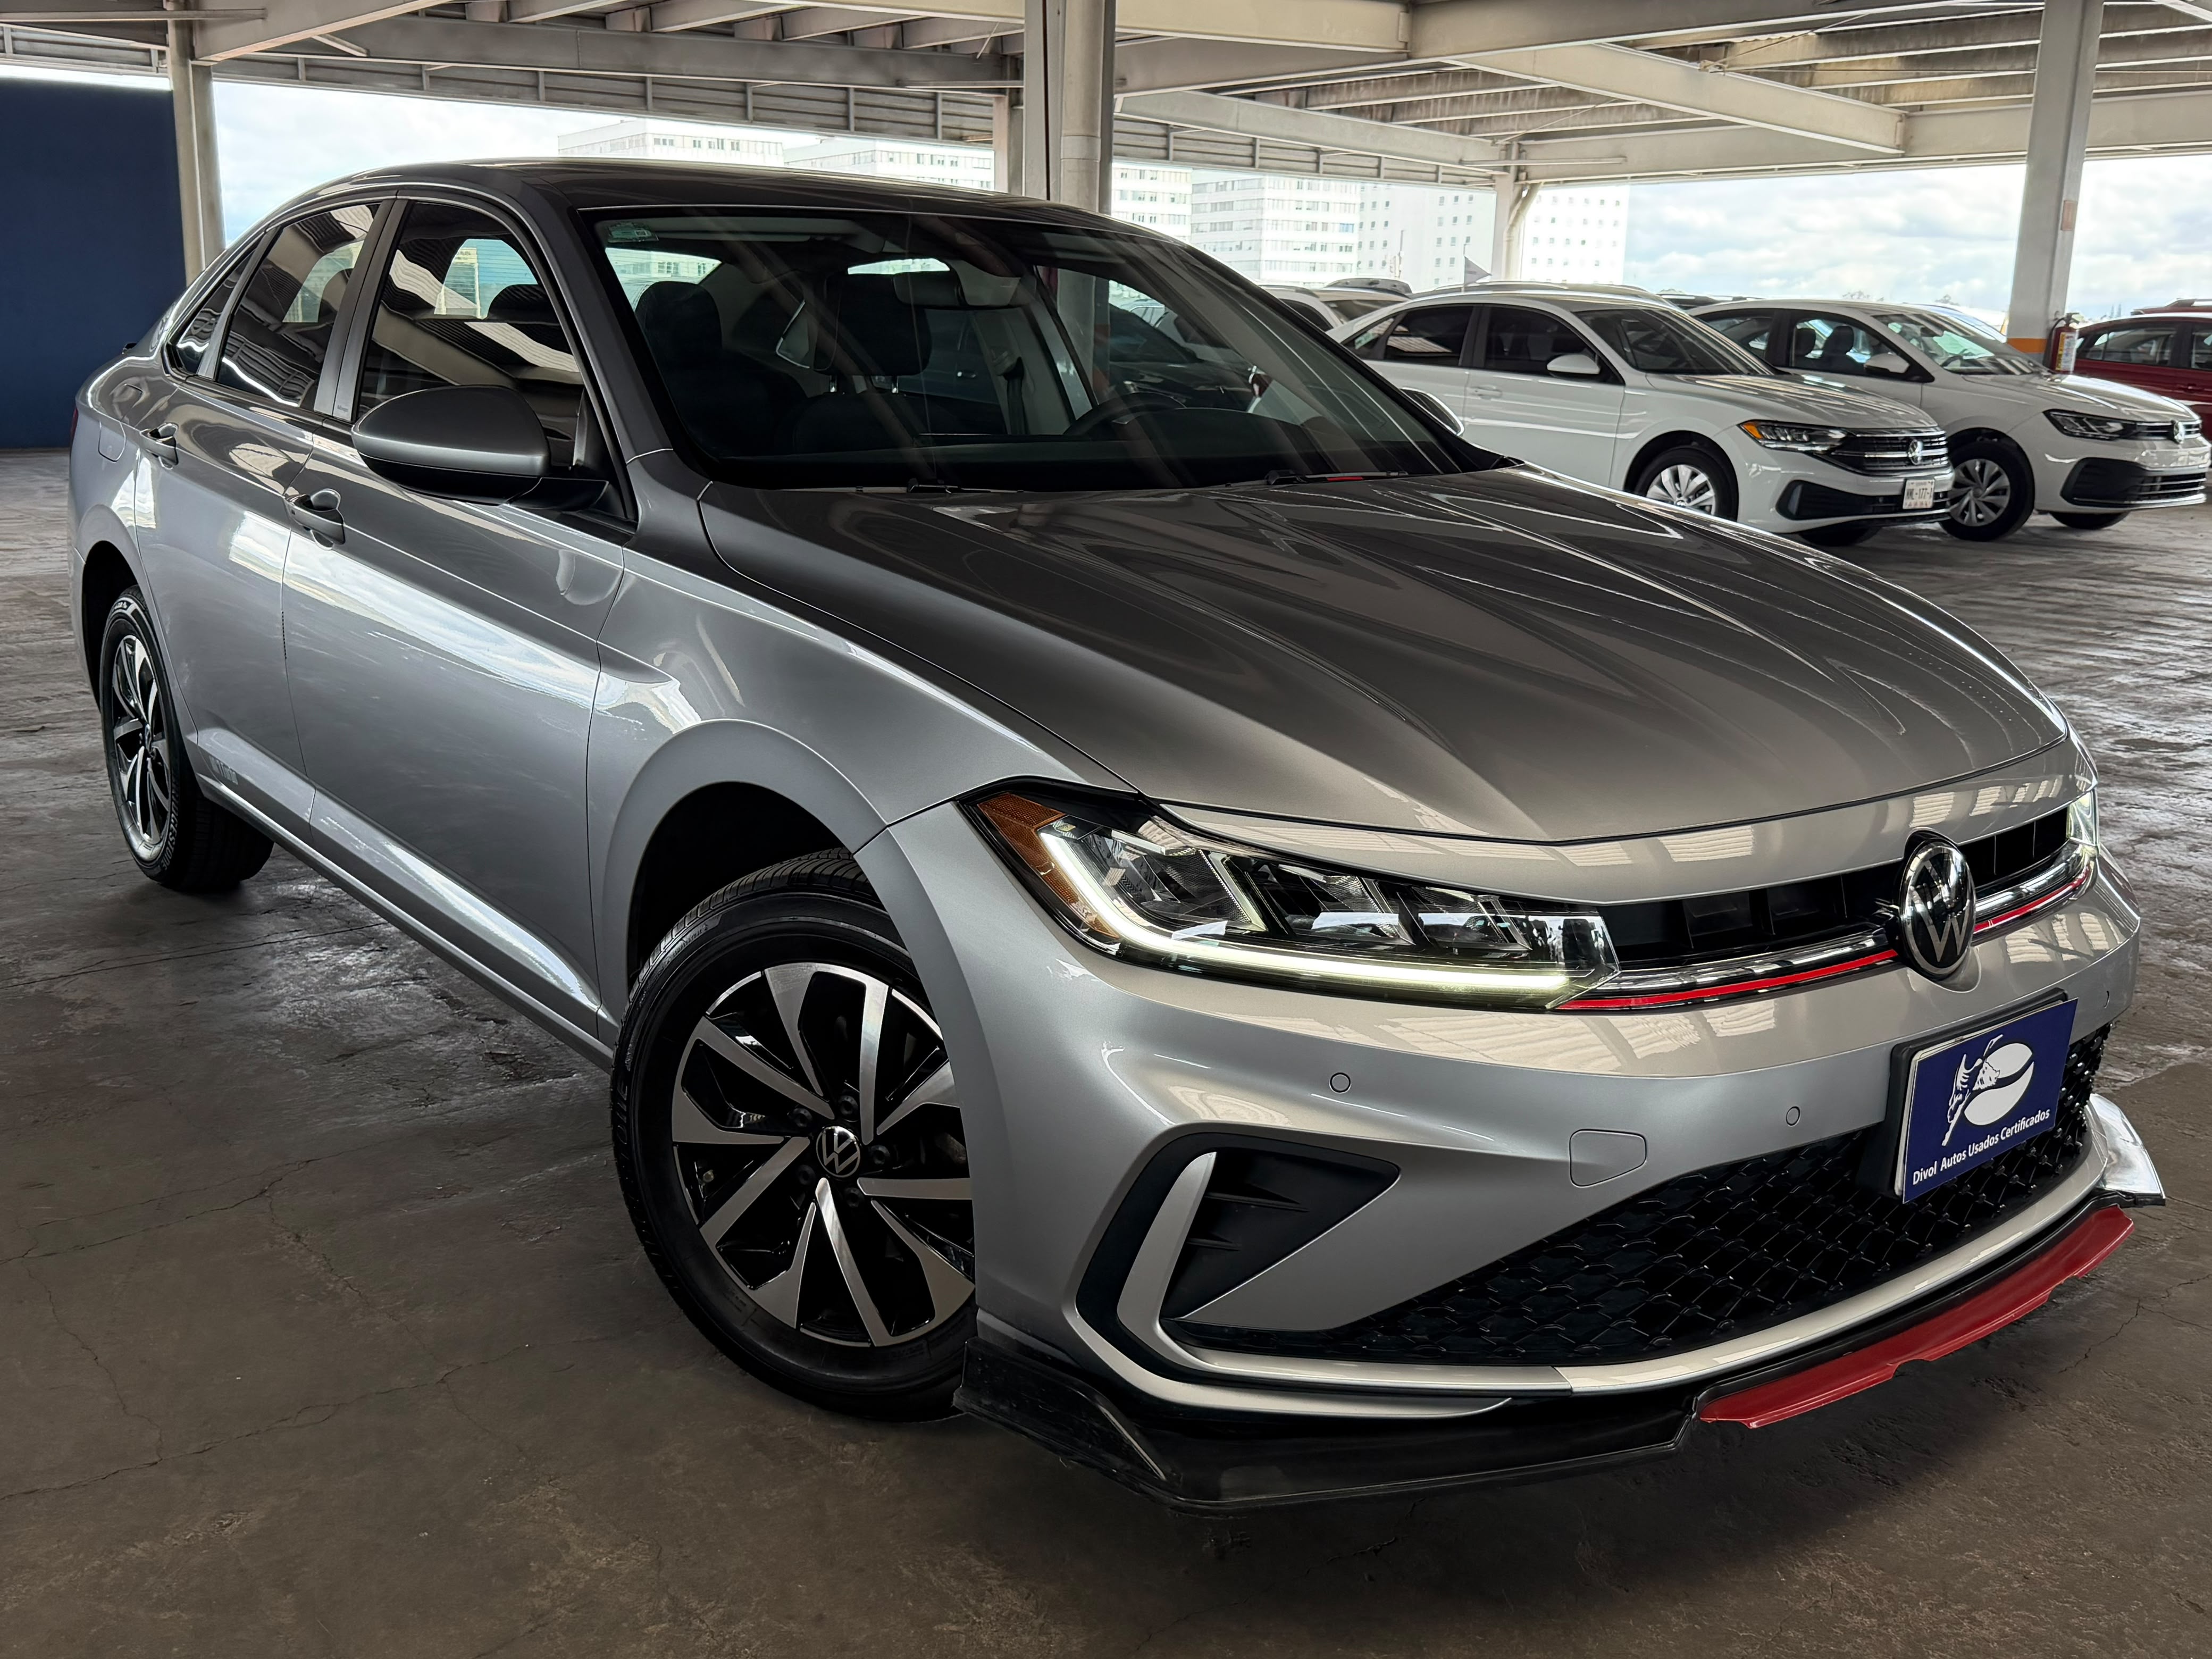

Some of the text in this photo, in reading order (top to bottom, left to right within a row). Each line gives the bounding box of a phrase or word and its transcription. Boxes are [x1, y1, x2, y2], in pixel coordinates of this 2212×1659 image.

[1913, 1109, 2050, 1185] Divol Autos Usados Certificados
